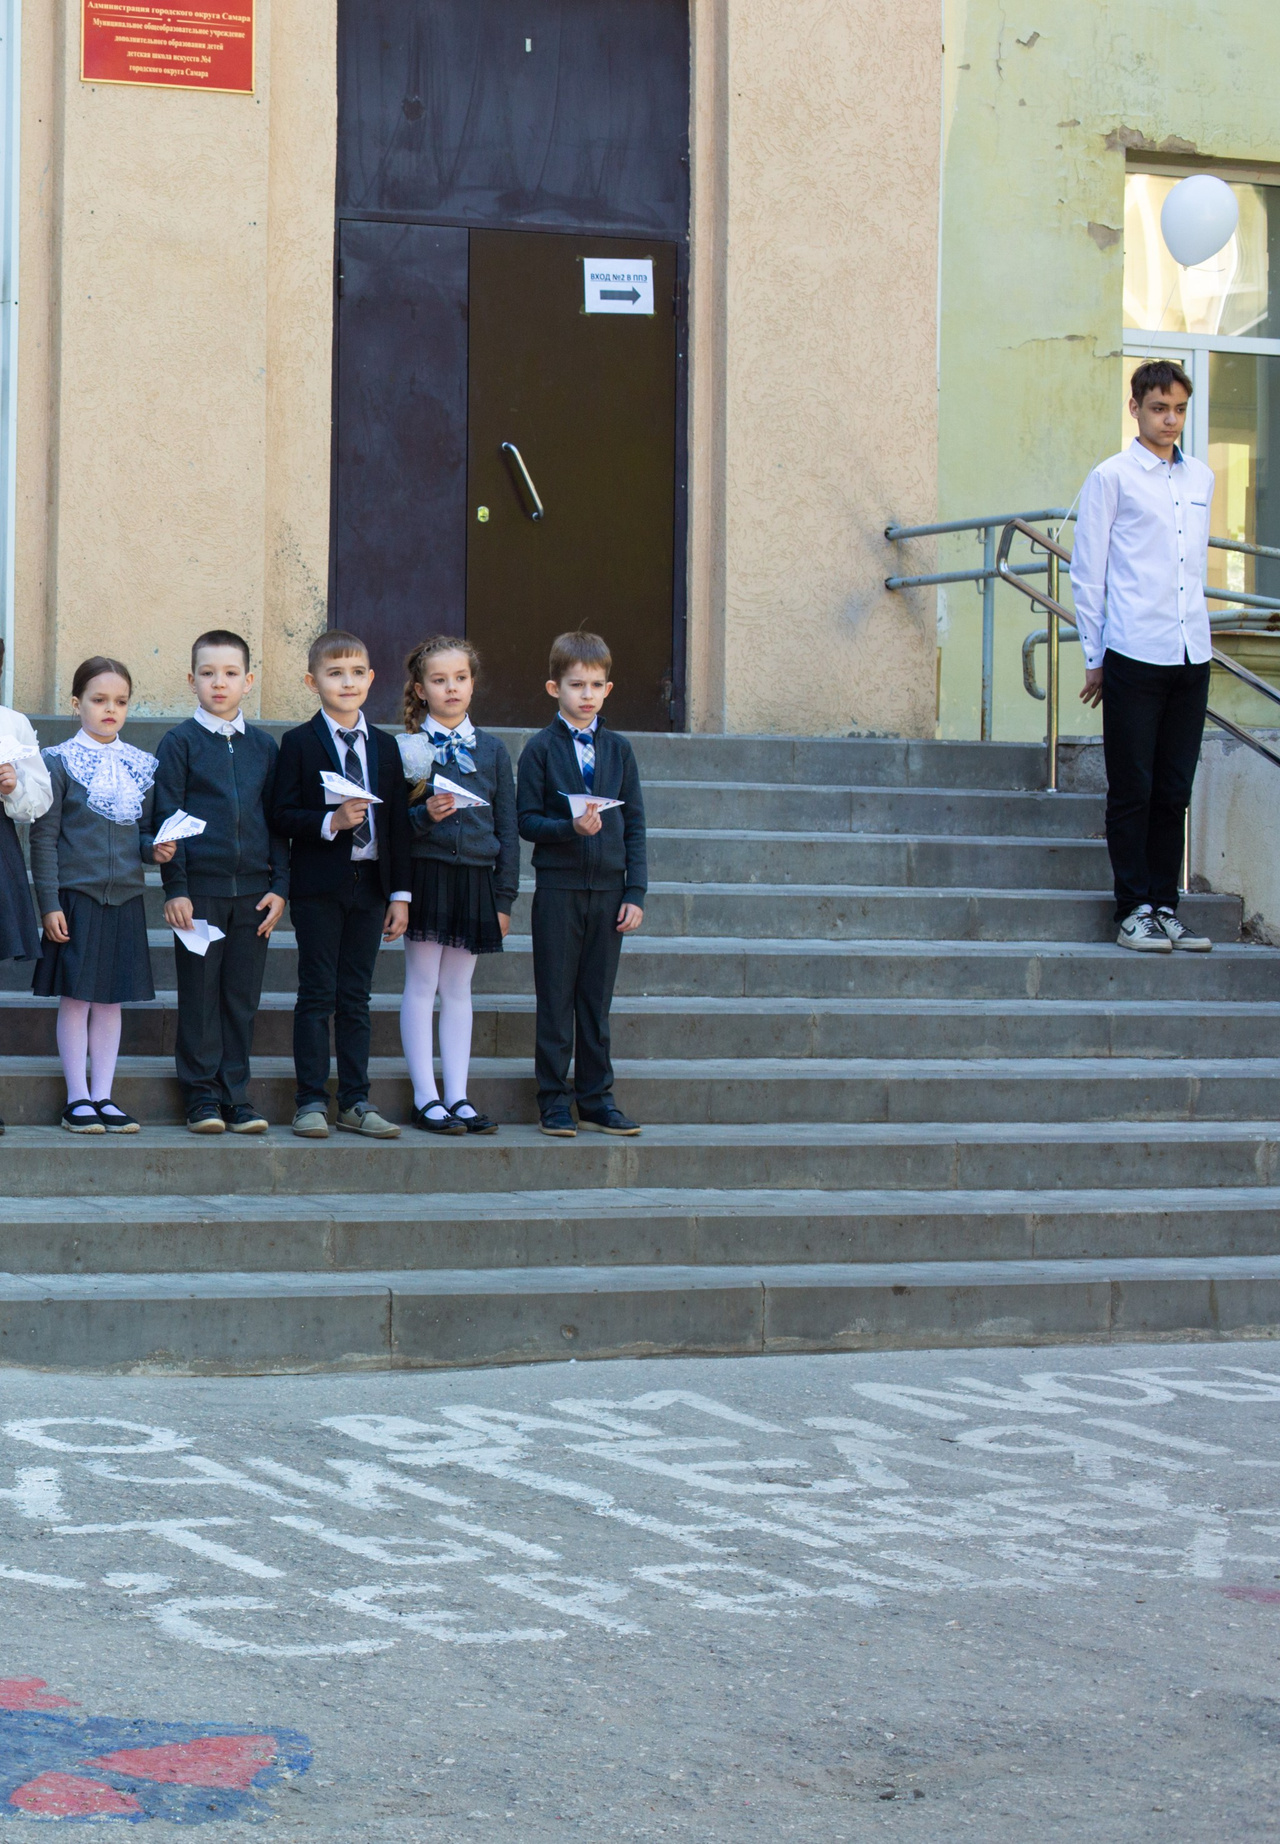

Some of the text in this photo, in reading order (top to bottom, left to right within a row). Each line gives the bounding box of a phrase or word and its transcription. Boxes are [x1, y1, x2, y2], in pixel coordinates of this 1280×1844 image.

[88, 2, 251, 23] Администрация городского округа Самара
[164, 68, 184, 76] округа
[185, 68, 209, 78] Самара
[590, 273, 611, 282] ВХОД
[314, 1388, 912, 1470] ВАМ,
[849, 1365, 1280, 1422] ЛЮБ
[53, 1513, 562, 1580] ТЫ
